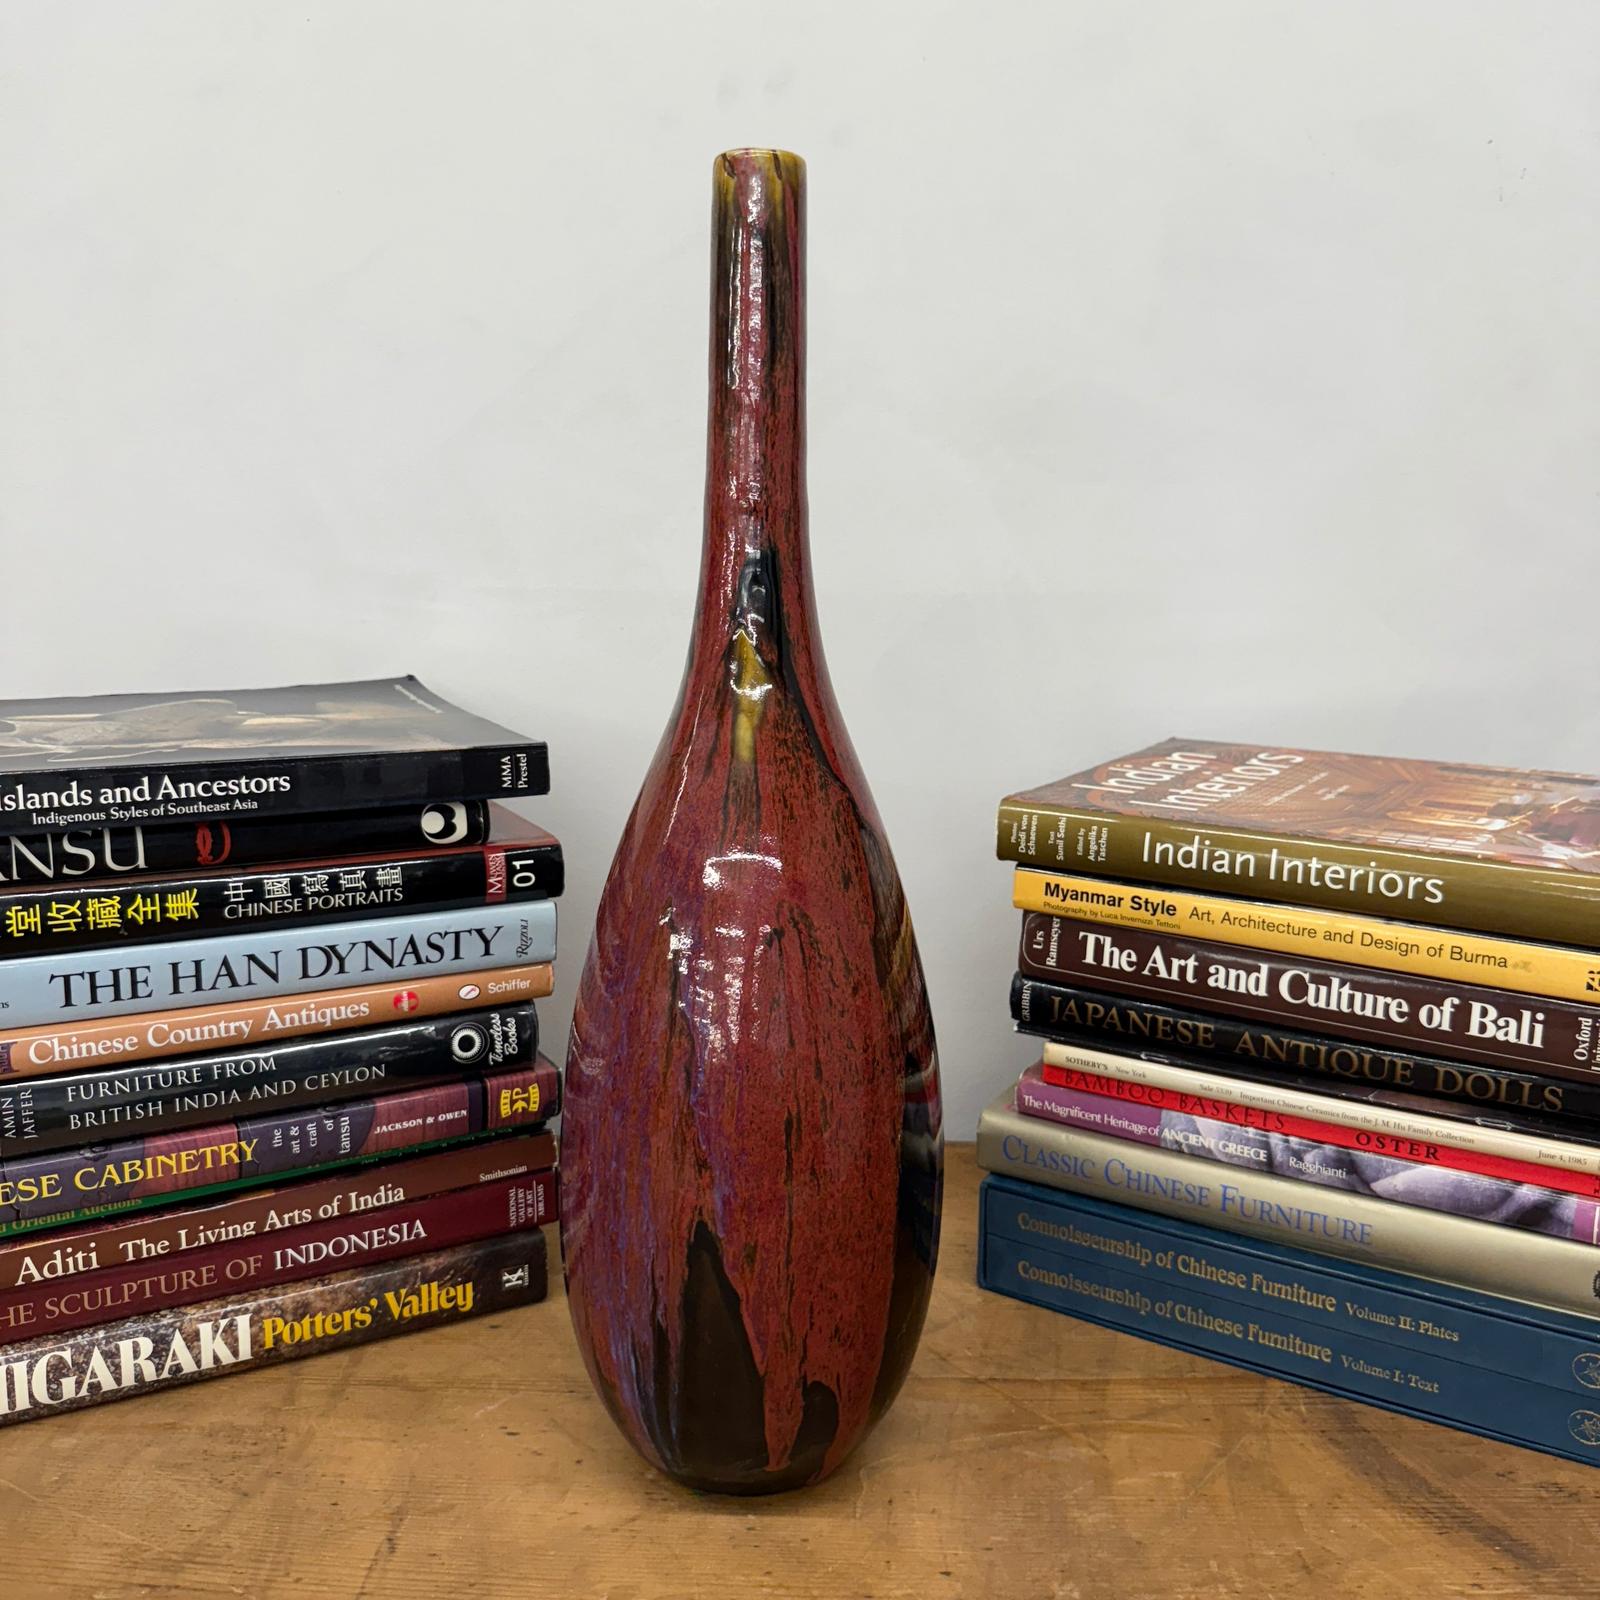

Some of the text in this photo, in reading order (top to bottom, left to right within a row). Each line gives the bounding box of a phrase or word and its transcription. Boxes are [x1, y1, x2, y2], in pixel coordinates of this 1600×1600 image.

[501, 755, 513, 788] MMA
[517, 754, 529, 789] Prestel
[1070, 751, 1217, 794] Indian
[1129, 752, 1304, 811] Interiors
[0, 775, 291, 812] slands and Ancestors
[32, 799, 258, 826] Indigenous Styles of Southeast Asia
[0, 826, 148, 882] NSU
[1019, 830, 1028, 853] Deidi
[1028, 814, 1038, 855] Schaewen
[1056, 816, 1067, 860] Sunil Sethi
[1087, 825, 1098, 861] Angelika
[1098, 827, 1108, 861] Taschen
[223, 866, 403, 902] 中國寫真畫
[512, 859, 536, 888] 01
[1142, 832, 1444, 903] Indian Interiors
[6, 887, 200, 937] 堂收藏全集
[224, 887, 403, 920] CHINESE PORTRAITS
[1043, 901, 1088, 916] Photography
[1090, 908, 1098, 917] by
[1100, 911, 1118, 920] Luca
[1033, 930, 1044, 950] Urs
[1044, 882, 1508, 968] Myanmar Style Art, Architecture and Design of Burma
[1046, 915, 1062, 967] Ramseyer
[48, 925, 504, 1009] THE HAN DYNASTY
[488, 979, 531, 994] Schiffer
[1023, 981, 1032, 1021] GRIBBIN
[1078, 931, 1137, 972] The
[1141, 946, 1199, 984] Art
[1207, 963, 1269, 997] and
[1278, 969, 1410, 1023] Culture
[1418, 997, 1460, 1032] of
[1465, 1000, 1545, 1049] Bali
[29, 1001, 370, 1065] Chinese Country Antiques
[489, 1012, 502, 1066] Timeless
[504, 1017, 519, 1056] Books
[1573, 1017, 1593, 1060] Oxford
[1050, 996, 1565, 1112] JAPANESE ANTIQUE DOLLS
[1065, 1056, 1147, 1080] SOTHEBY'S New York
[67, 1057, 277, 1102] FURNITURE FROM
[70, 1064, 386, 1130] BRITISH INDIA AND CEYLON
[1064, 1067, 1284, 1129] BAMBOO BASKETS
[1, 1097, 17, 1138] AMIN
[20, 1088, 39, 1140] JAFFER
[306, 1121, 317, 1147] craft
[324, 1119, 334, 1131] of
[374, 1109, 467, 1135] JACKSON & OWEN
[1023, 1095, 1268, 1162] The Magnificent Heritage of ANCIENT GREECE
[1240, 1092, 1275, 1107] Important
[1276, 1098, 1304, 1111] Chinese
[1306, 1104, 1341, 1119] Ceramics
[1341, 1111, 1359, 1123] from
[1360, 1115, 1373, 1125] the
[1407, 1124, 1434, 1138] Family
[1435, 1129, 1475, 1144] Collection
[272, 1127, 282, 1148] the
[290, 1126, 300, 1154] art &
[338, 1116, 350, 1155] tansu
[1355, 1132, 1441, 1161] OSTER
[1536, 1150, 1557, 1160] June
[74, 1138, 259, 1191] CABINETRY
[479, 1164, 528, 1184] Smithsonian
[1289, 1156, 1347, 1180] Ragghianti
[517, 1188, 525, 1223] GALLERY
[1002, 1135, 1373, 1245] CLASSIC CHINESE FURNITURE
[14, 1184, 405, 1286] Aditi The Living Arts of India
[45, 1264, 218, 1319] SCULPTURE
[225, 1255, 262, 1281] OF
[274, 1219, 427, 1270] INDONESIA
[1017, 1212, 1151, 1267] Connoisseurship
[1155, 1251, 1175, 1270] of
[1177, 1255, 1246, 1288] Chinese
[1251, 1273, 1337, 1312] Furniture
[1345, 1302, 1395, 1327] Volume
[1419, 1321, 1460, 1342] Plates
[385, 1281, 474, 1321] Valley
[1017, 1260, 1151, 1315] Connoisseurship
[1155, 1300, 1174, 1318] of
[1174, 1305, 1244, 1338] Chinese
[1248, 1323, 1332, 1363] Furniture
[1341, 1353, 1390, 1378] Volume
[1408, 1373, 1440, 1394] Text
